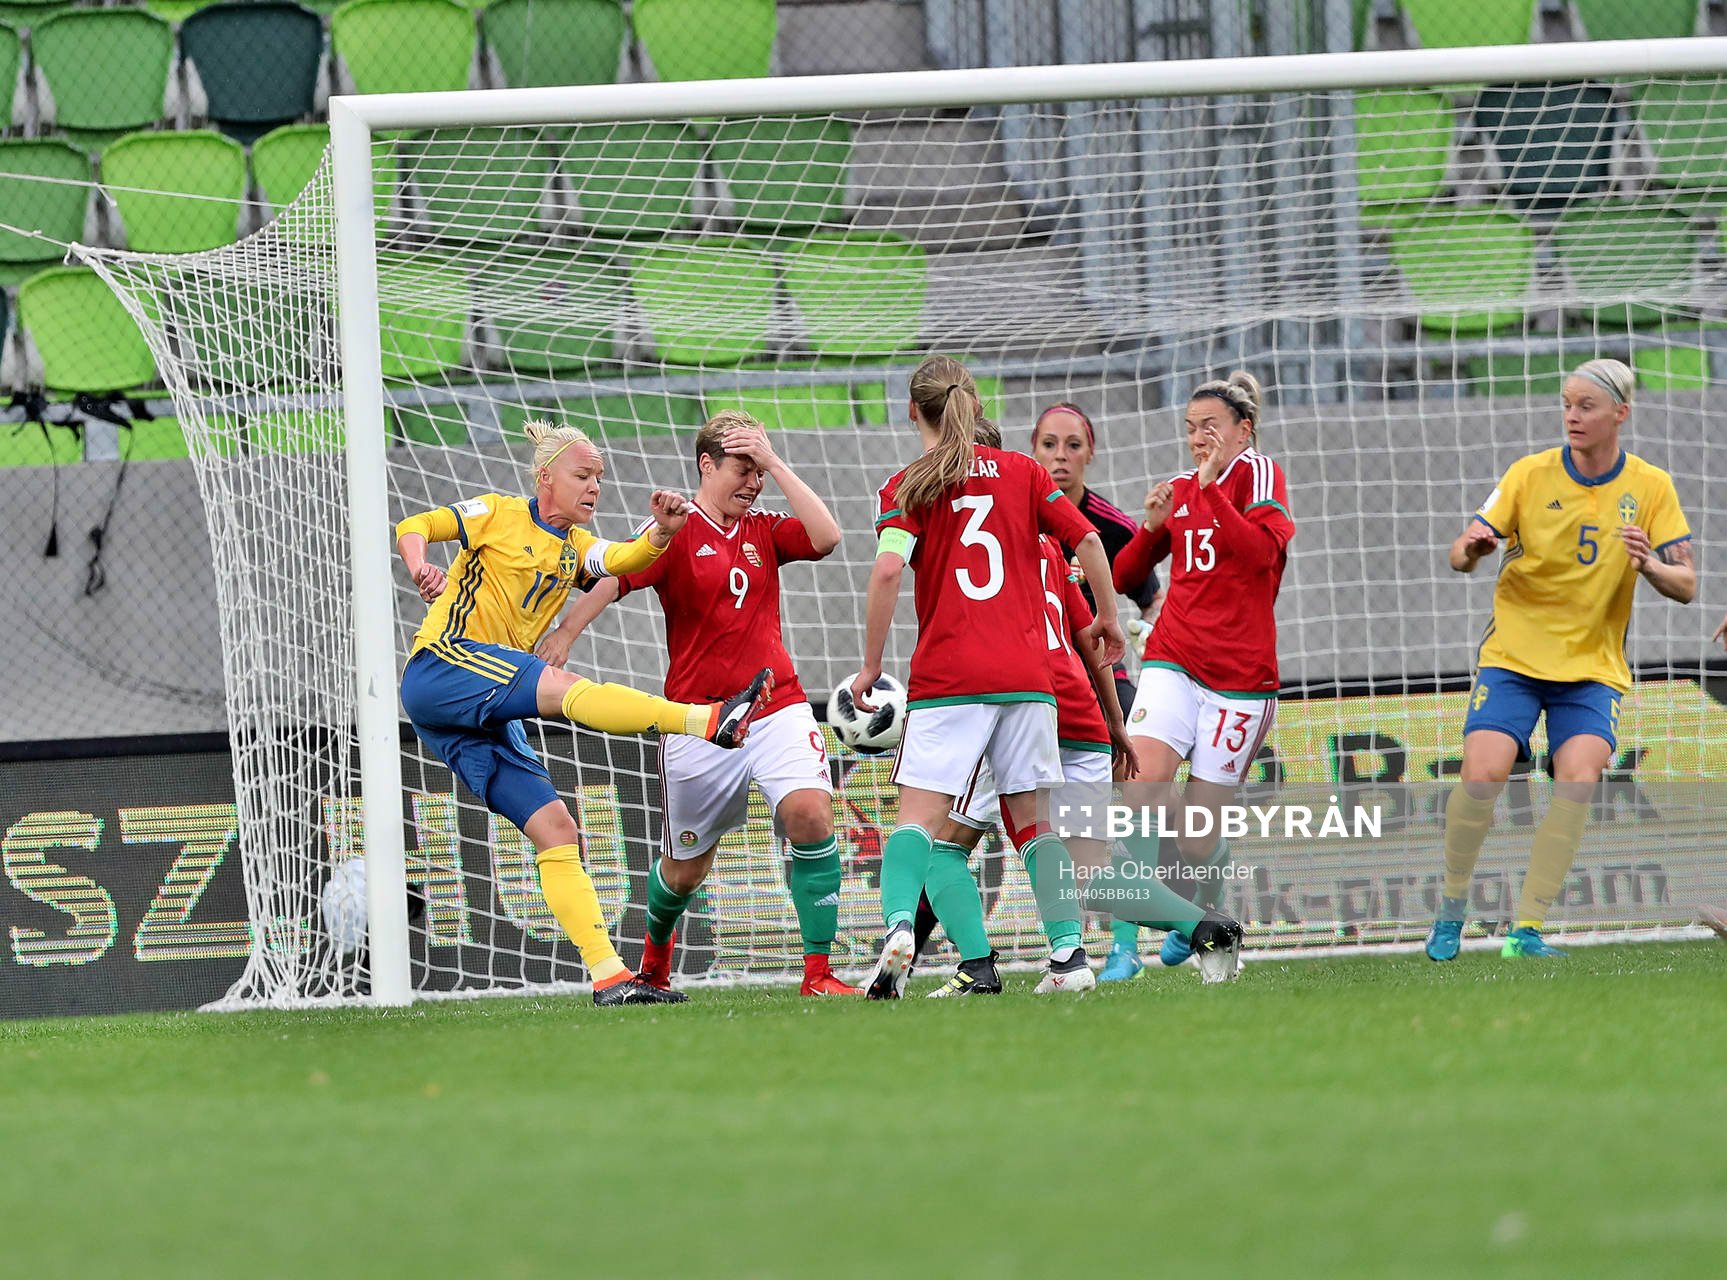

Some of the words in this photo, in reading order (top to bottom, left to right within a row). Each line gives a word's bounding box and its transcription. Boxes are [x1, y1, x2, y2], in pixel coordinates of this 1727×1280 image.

[952, 494, 1005, 600] 3
[1184, 528, 1216, 572] 13
[1577, 525, 1599, 565] 5
[521, 571, 558, 613] 17
[729, 567, 749, 609] 9
[808, 730, 826, 763] 9
[1212, 708, 1252, 753] 13
